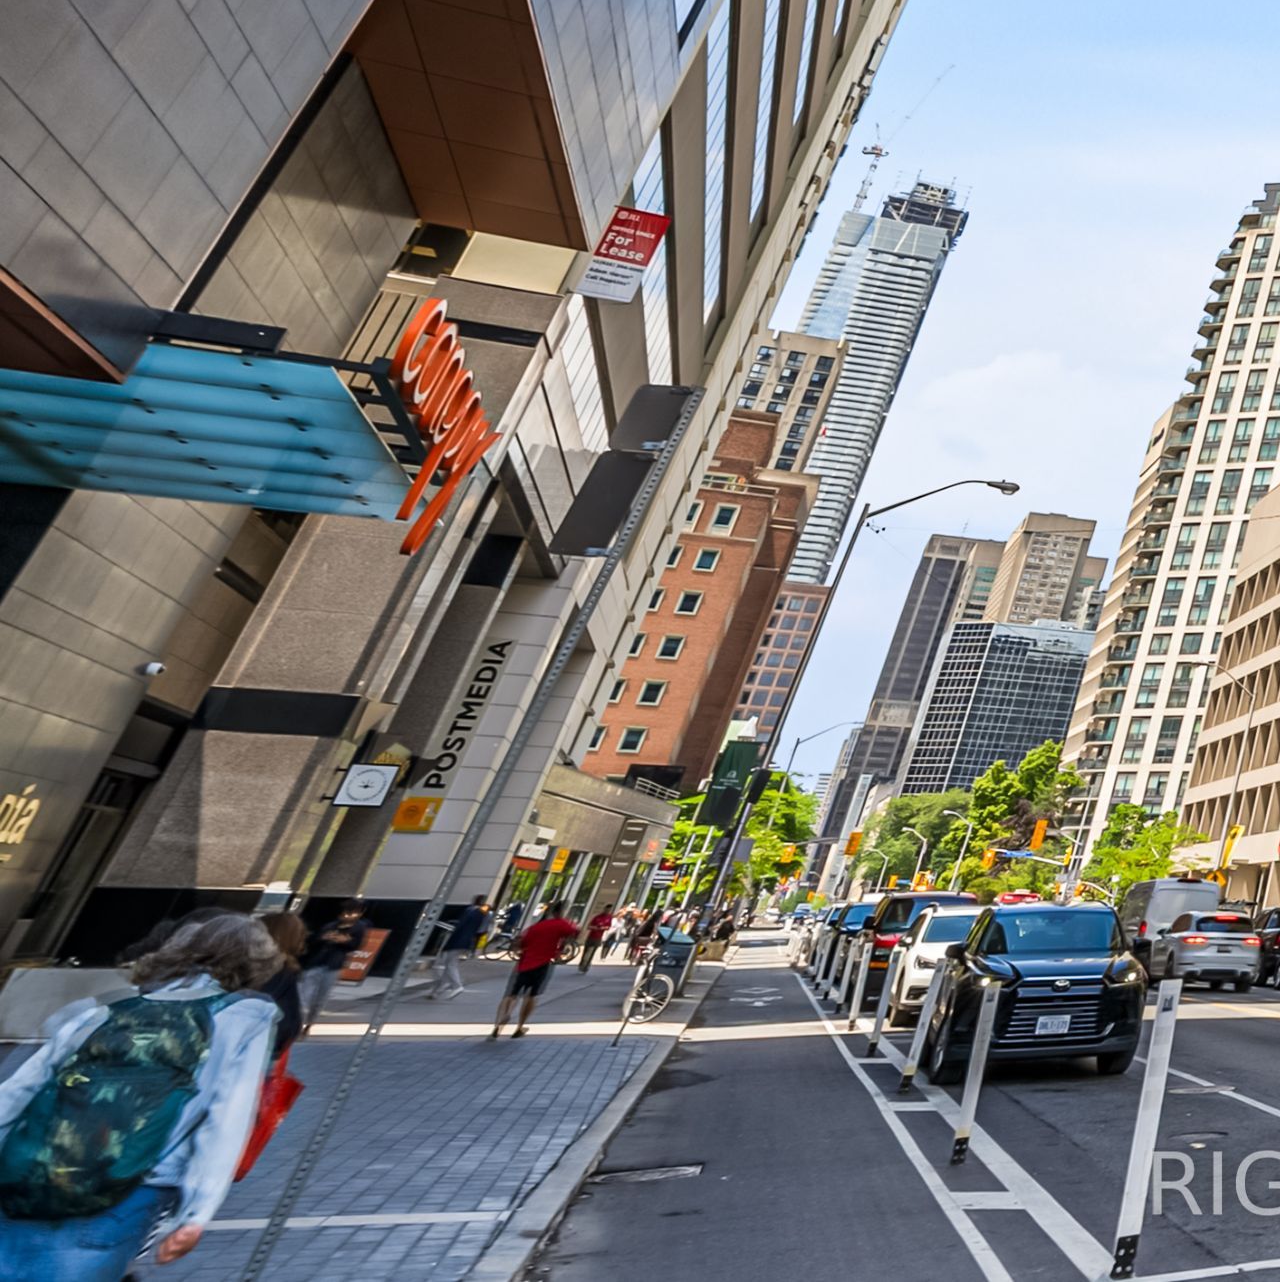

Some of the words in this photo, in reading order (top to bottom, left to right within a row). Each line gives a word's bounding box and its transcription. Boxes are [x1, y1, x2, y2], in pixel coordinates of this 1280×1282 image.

[605, 231, 633, 246] For
[599, 242, 645, 261] Lease
[422, 640, 513, 789] POSTMEDIA
